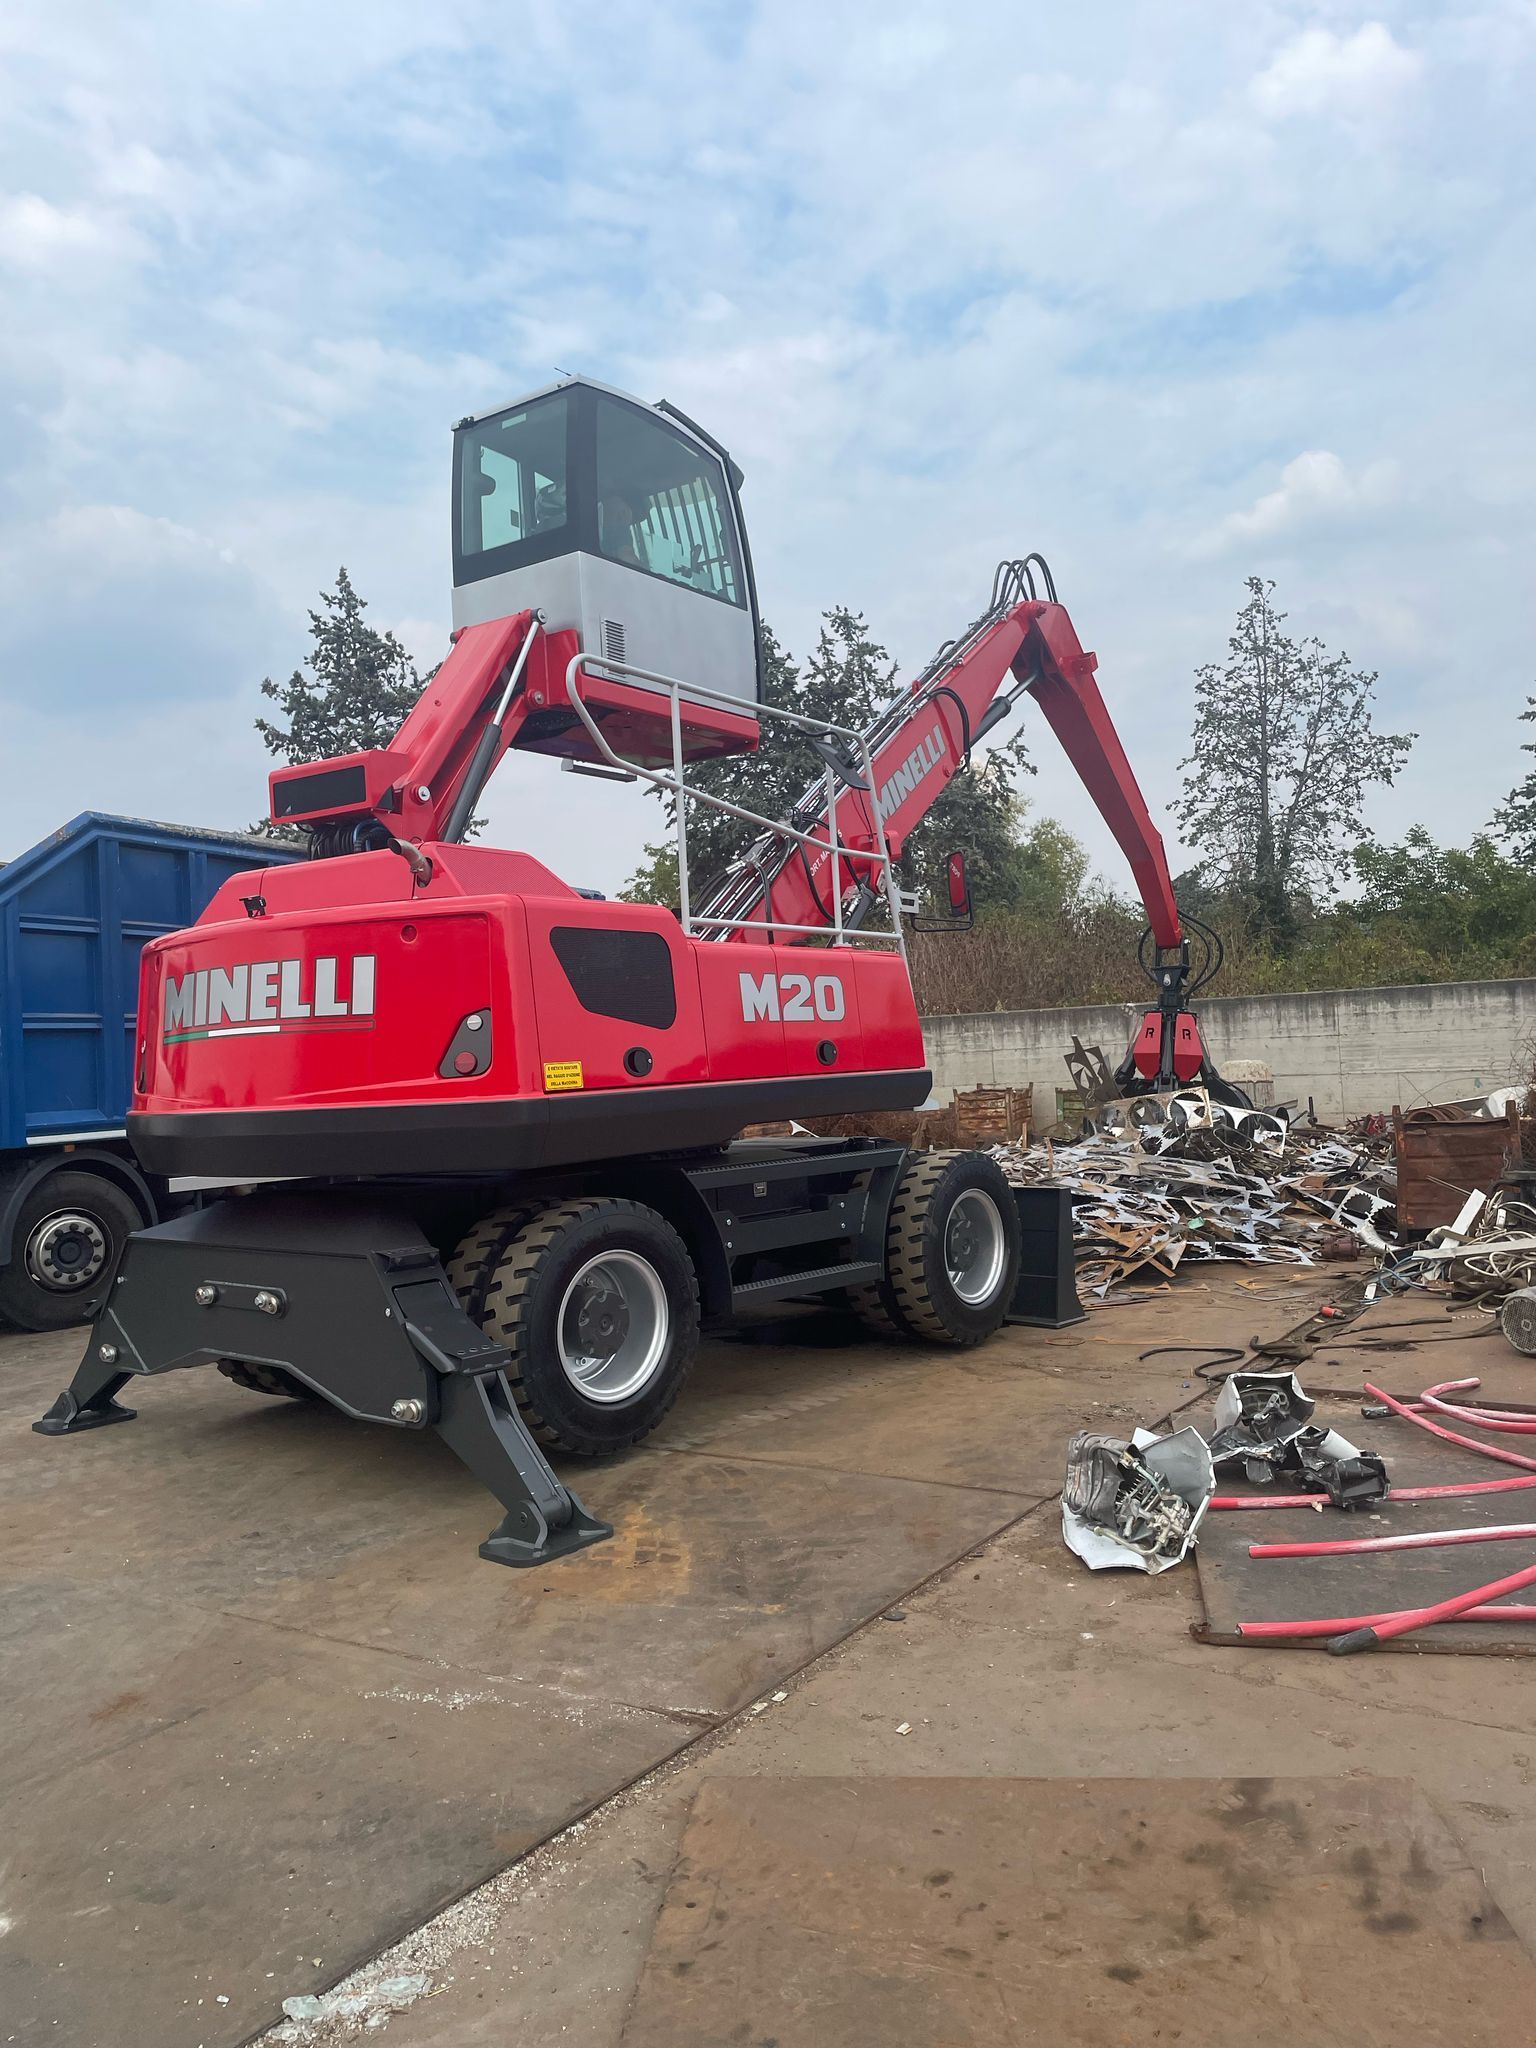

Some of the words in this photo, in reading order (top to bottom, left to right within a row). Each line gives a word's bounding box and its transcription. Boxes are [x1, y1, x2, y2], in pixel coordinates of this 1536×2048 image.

[872, 724, 946, 829] MINELLI
[164, 956, 375, 1032] MINELLI
[739, 973, 845, 1021] M20
